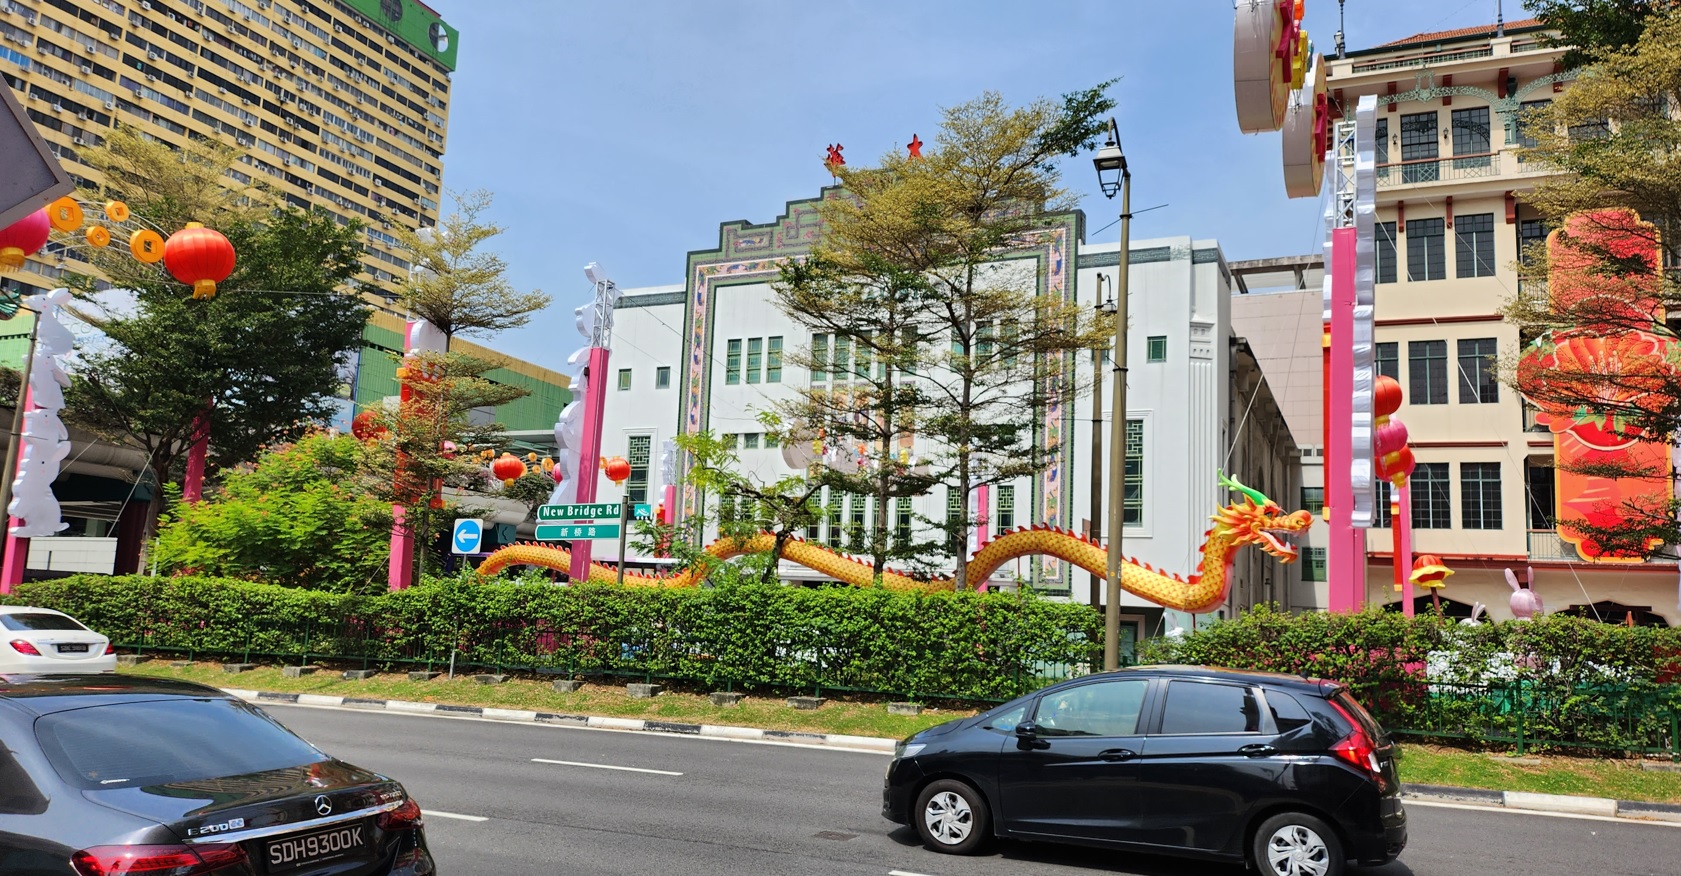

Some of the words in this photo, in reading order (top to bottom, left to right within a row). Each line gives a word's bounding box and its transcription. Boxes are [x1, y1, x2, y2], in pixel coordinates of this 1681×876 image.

[543, 506, 565, 517] New
[567, 505, 603, 518] Bridge
[606, 504, 620, 515] Rd
[560, 527, 596, 537] 新桥路
[200, 823, 229, 835] 200
[269, 826, 364, 865] SDH9300K
